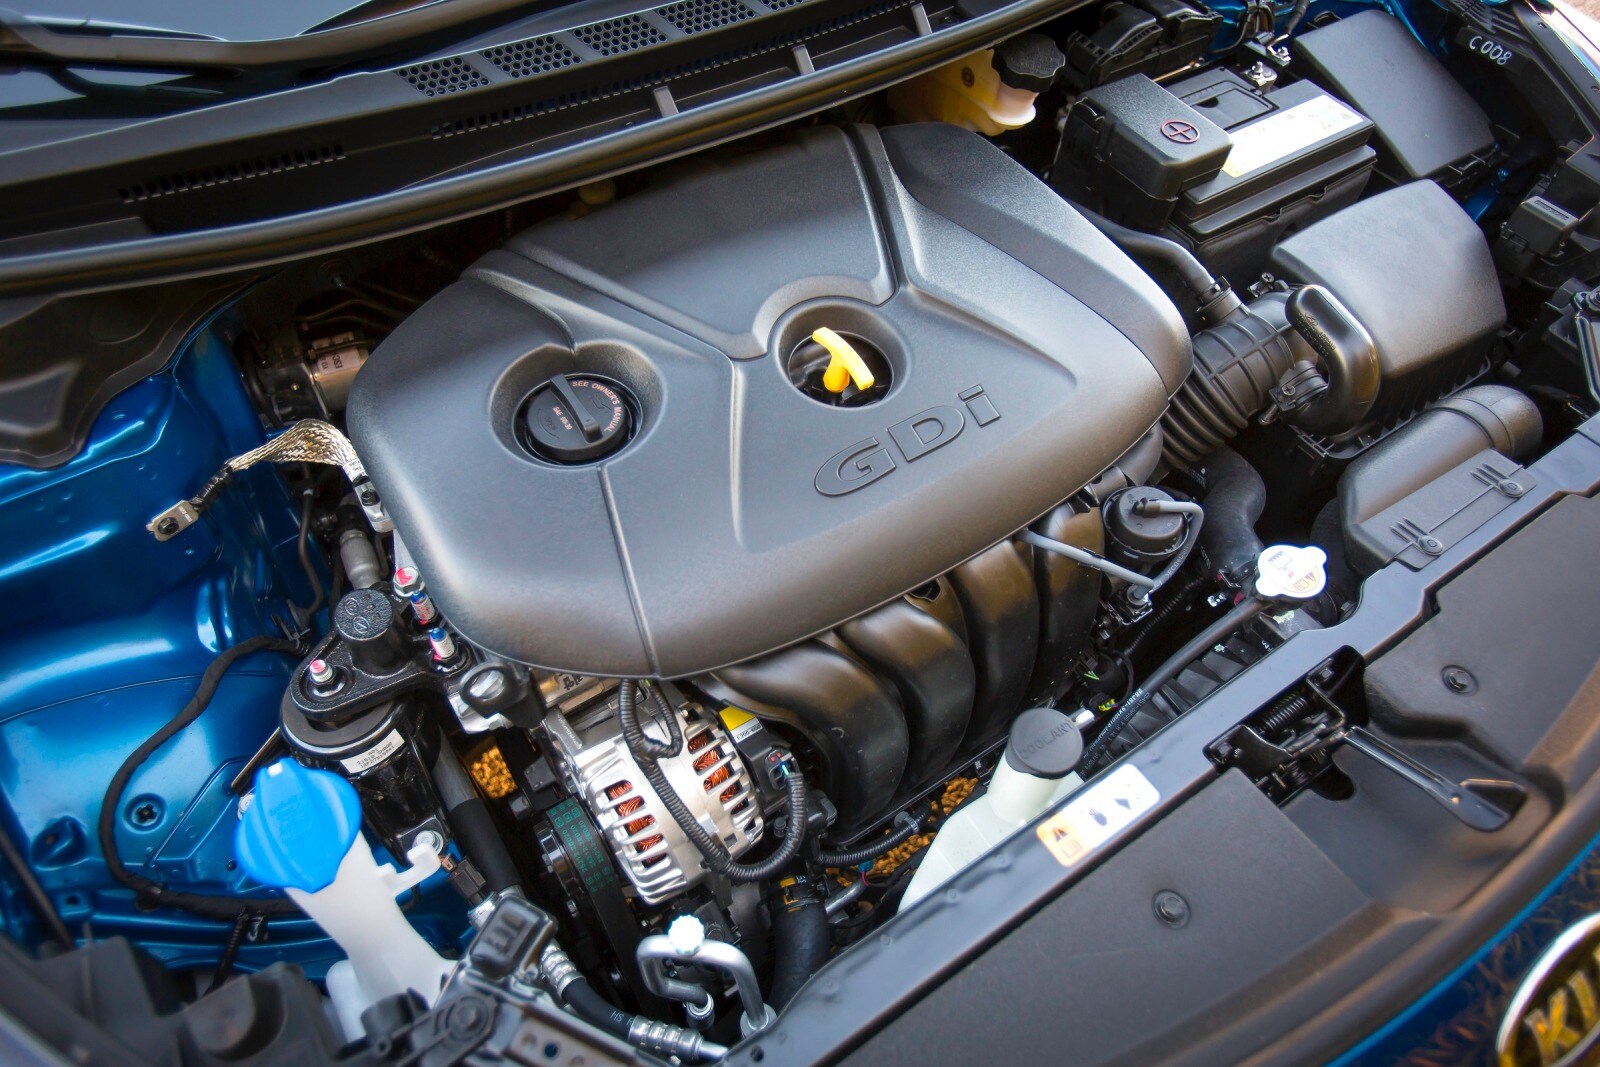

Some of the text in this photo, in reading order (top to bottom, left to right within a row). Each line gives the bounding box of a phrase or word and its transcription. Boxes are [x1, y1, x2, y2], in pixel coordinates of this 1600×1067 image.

[591, 382, 620, 405] OWNER'S
[603, 406, 622, 432] MANUAL
[814, 383, 1002, 498] GDi
[1523, 943, 1600, 1067] KI
